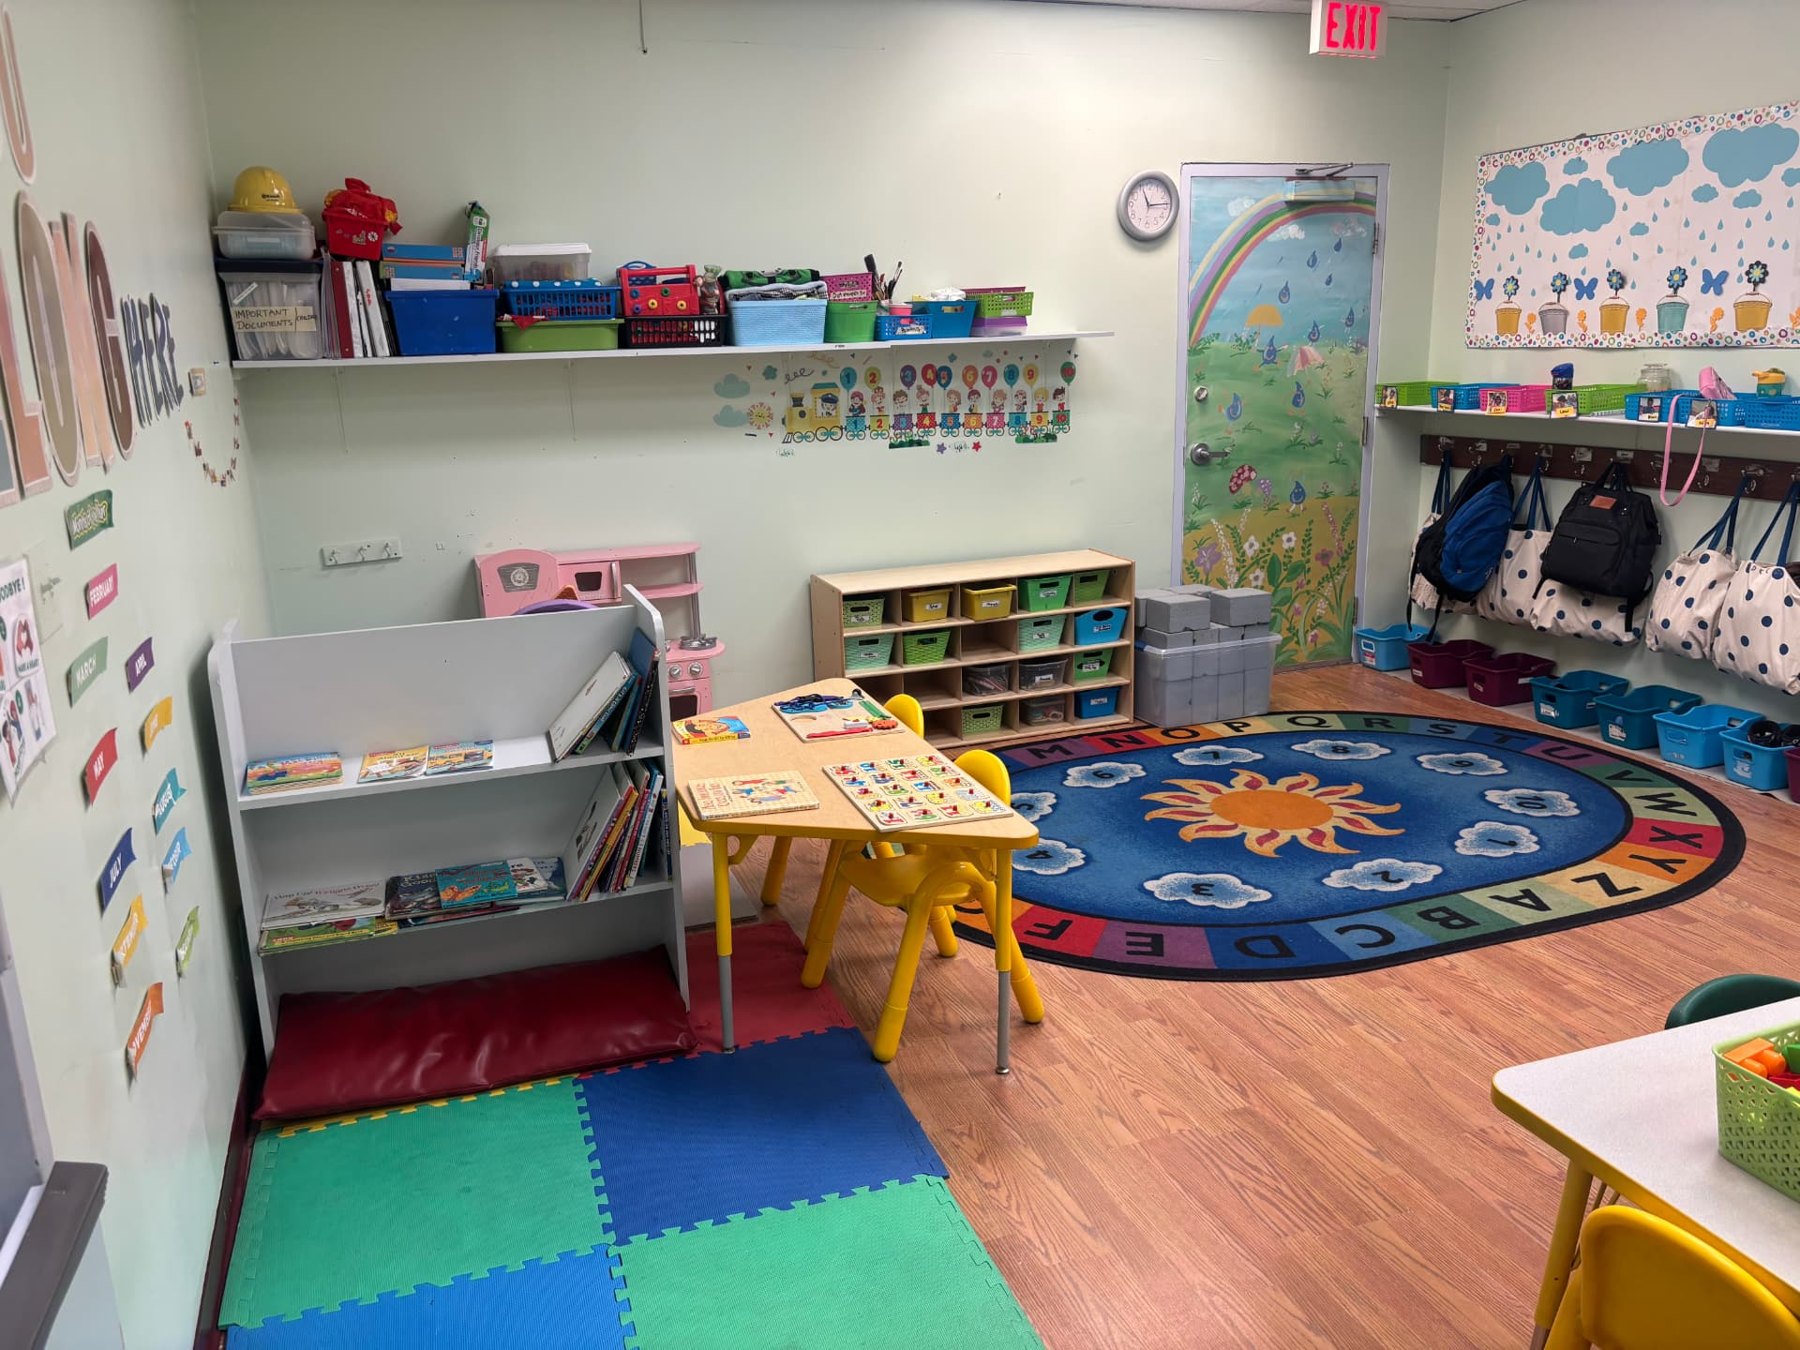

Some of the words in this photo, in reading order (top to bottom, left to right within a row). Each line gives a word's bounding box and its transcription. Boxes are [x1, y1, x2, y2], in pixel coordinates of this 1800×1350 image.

[1326, 2, 1382, 51] EXIT
[235, 308, 288, 319] IMPORTANT
[236, 320, 293, 330] DOCUMENTS
[0, 189, 135, 505] LONG
[845, 373, 850, 384] 1
[869, 372, 877, 384] 2
[904, 370, 912, 382] 3
[926, 369, 934, 380] 4
[941, 371, 948, 384] 5
[966, 369, 973, 381] 6
[986, 370, 993, 382] 7
[1008, 370, 1015, 380] 8
[1027, 369, 1035, 380] 9
[853, 420, 858, 429] 1
[876, 419, 883, 429] 2
[923, 416, 930, 427] 4
[970, 415, 977, 426] 6
[992, 415, 999, 425] 7
[1014, 415, 1021, 425] 8
[1036, 415, 1043, 424] 9
[1223, 721, 1252, 733] P
[1287, 715, 1329, 729] Q
[1364, 717, 1395, 730] R
[1427, 723, 1457, 735] S
[1103, 734, 1147, 748] N
[1160, 727, 1200, 740] O
[1494, 733, 1525, 744] T
[1026, 744, 1074, 759] M
[1202, 751, 1220, 760] 7
[1332, 745, 1349, 755] 8
[1543, 746, 1592, 762] U
[93, 752, 105, 780] MAY
[1448, 758, 1476, 769] 9
[1604, 769, 1653, 787] V
[1520, 795, 1547, 811] 10
[1633, 792, 1699, 817] W
[1487, 837, 1518, 848] 1
[1648, 825, 1703, 849] X
[1025, 850, 1053, 860] 4
[109, 853, 123, 888] JULY
[1628, 853, 1688, 875] Y
[1371, 870, 1405, 884] 2
[1571, 871, 1643, 898] Z
[1192, 883, 1215, 896] 3
[1489, 888, 1552, 914] A
[1416, 905, 1480, 931] B
[1023, 919, 1073, 941] F
[1333, 923, 1397, 949] C
[1126, 931, 1164, 958] E
[1233, 934, 1297, 959] D
